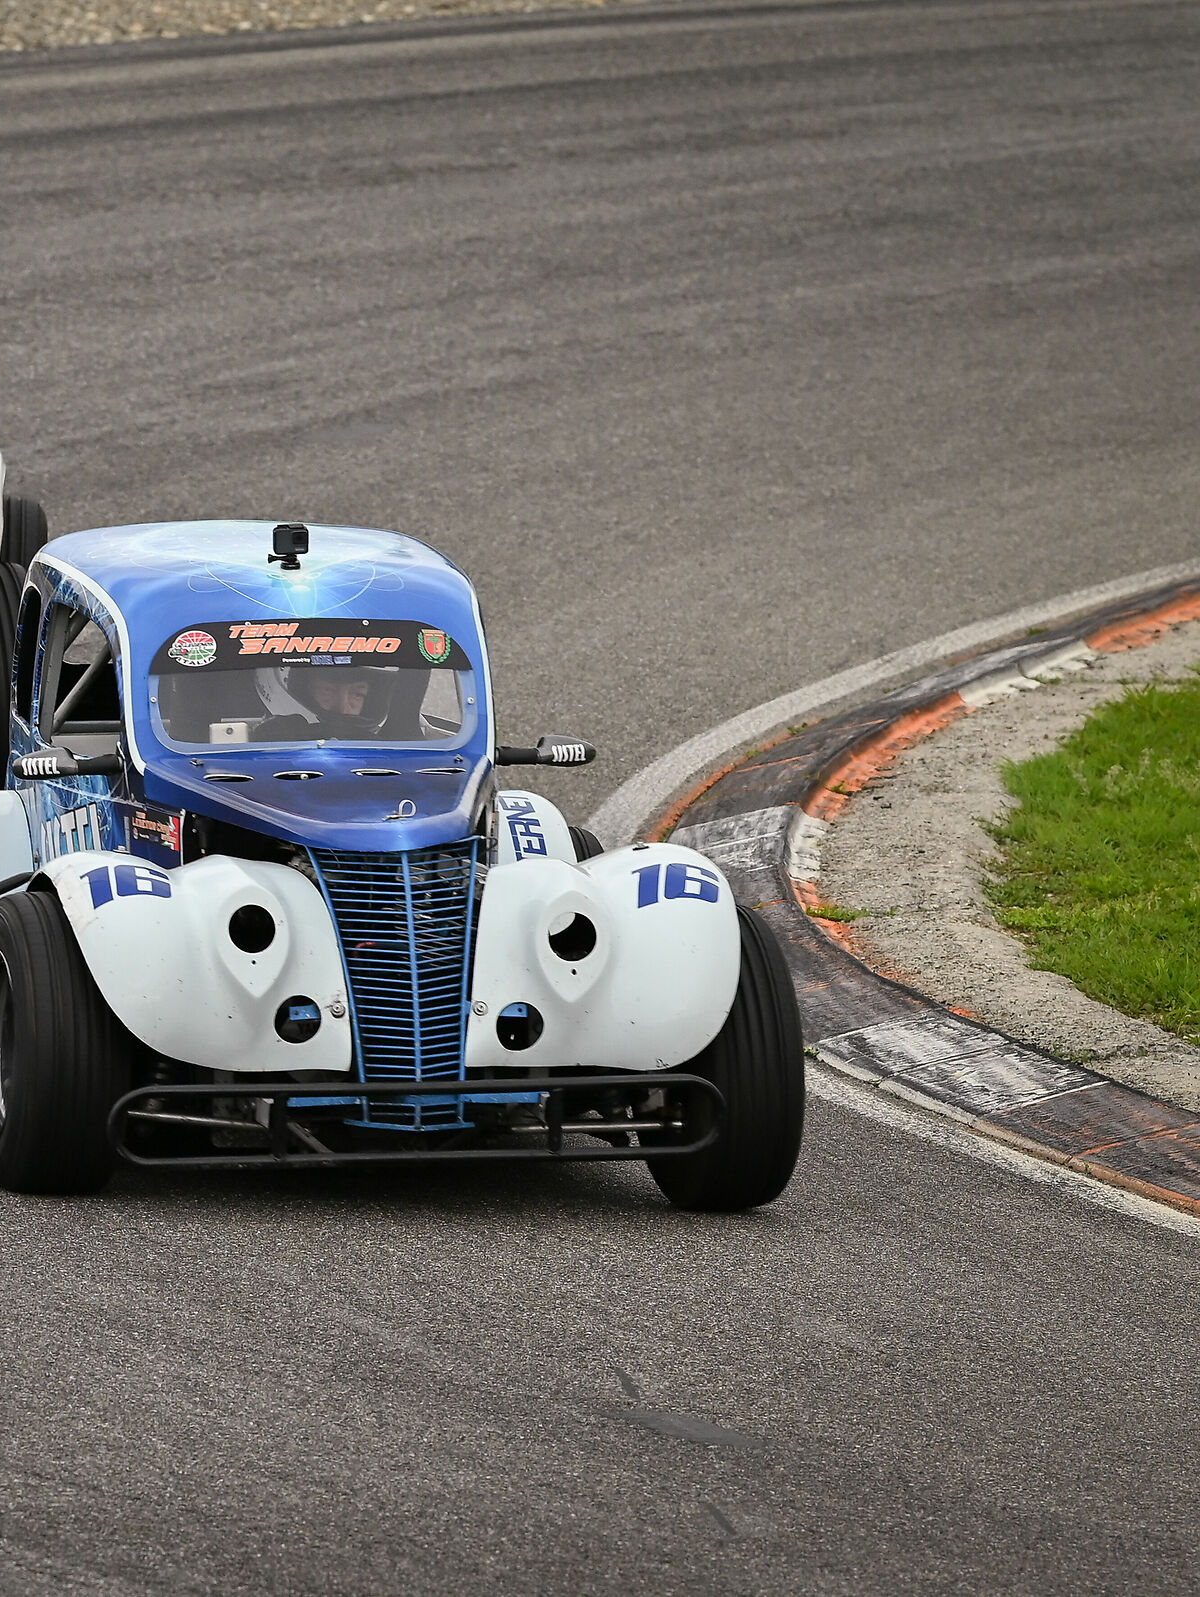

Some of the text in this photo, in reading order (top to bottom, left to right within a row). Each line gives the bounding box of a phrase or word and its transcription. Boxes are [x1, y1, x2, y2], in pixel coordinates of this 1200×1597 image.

[228, 622, 299, 639] TEAM
[238, 637, 402, 655] SANREMO
[176, 656, 216, 667] ITALIA
[551, 744, 586, 762] SISTEL
[21, 757, 61, 776] SISTEL
[80, 864, 172, 910] 16
[632, 862, 719, 909] 16
